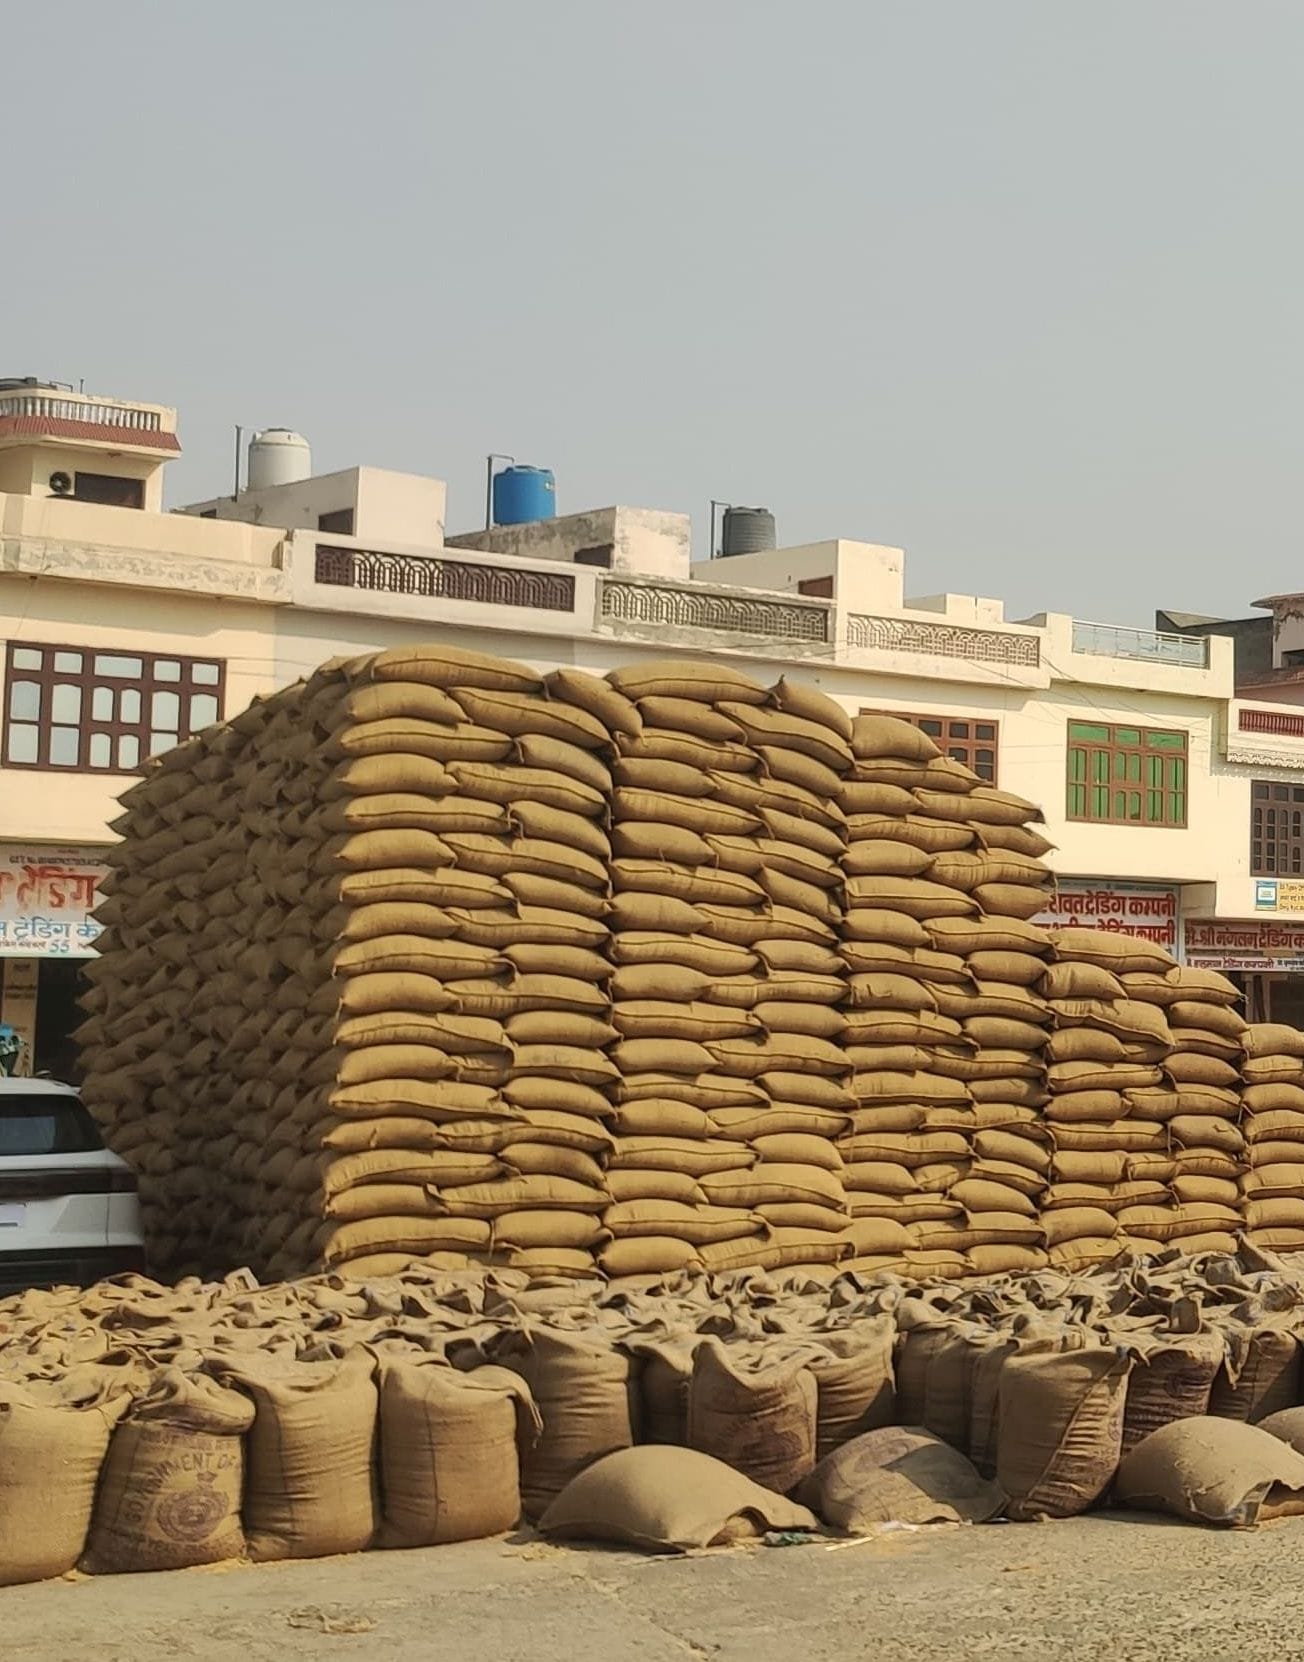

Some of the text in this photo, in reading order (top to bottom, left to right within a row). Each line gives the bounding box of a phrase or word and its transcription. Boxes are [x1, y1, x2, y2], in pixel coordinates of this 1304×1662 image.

[1085, 890, 1126, 915] ट्रेडिंग
[1129, 893, 1176, 917] कम्पनी
[14, 916, 71, 941] ट्रेडिंग
